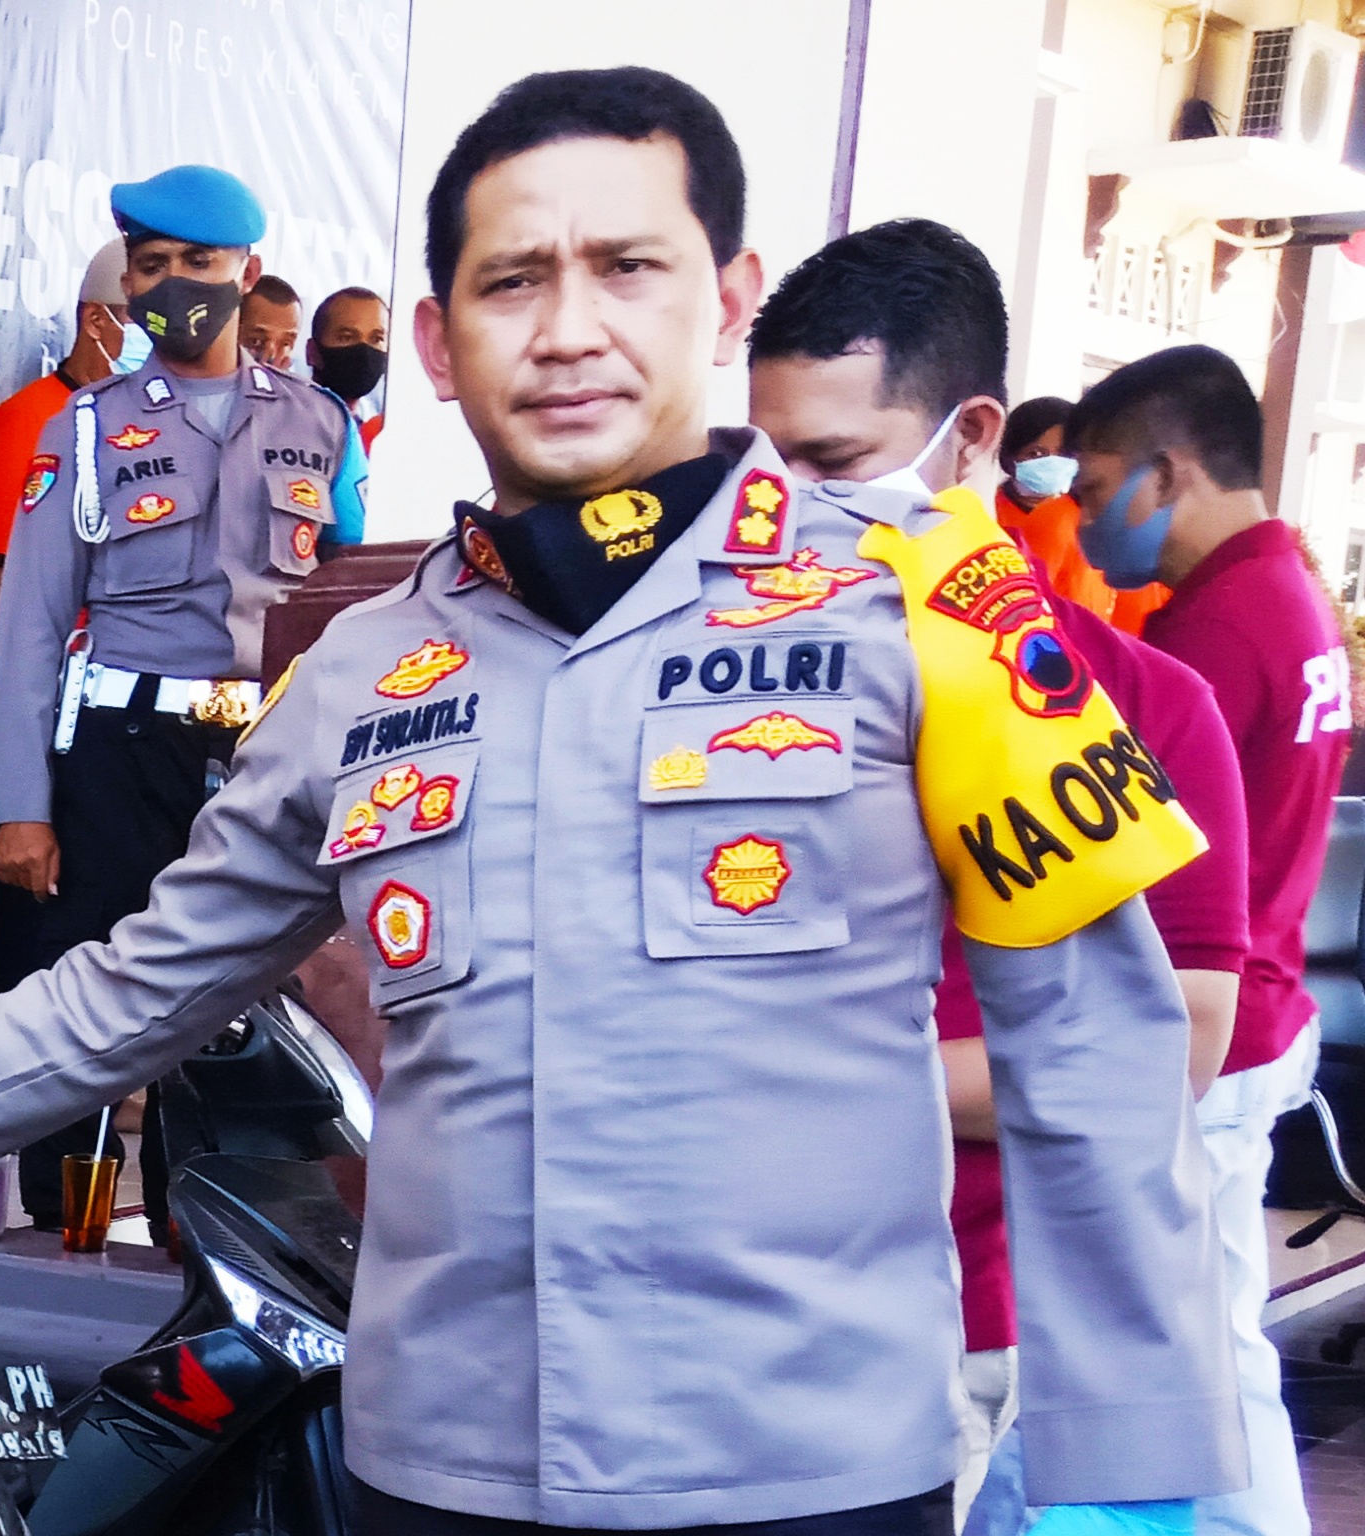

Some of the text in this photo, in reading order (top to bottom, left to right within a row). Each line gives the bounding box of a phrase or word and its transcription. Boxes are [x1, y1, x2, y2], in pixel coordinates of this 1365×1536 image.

[84, 0, 234, 78] POLRES
[115, 456, 177, 487] ARIE
[264, 448, 332, 475] POLRI
[606, 533, 654, 561] POLRI
[940, 546, 1025, 600] POLRE
[955, 559, 1030, 610] KLATE
[658, 642, 845, 700] POLRI
[959, 796, 1075, 901] KA
